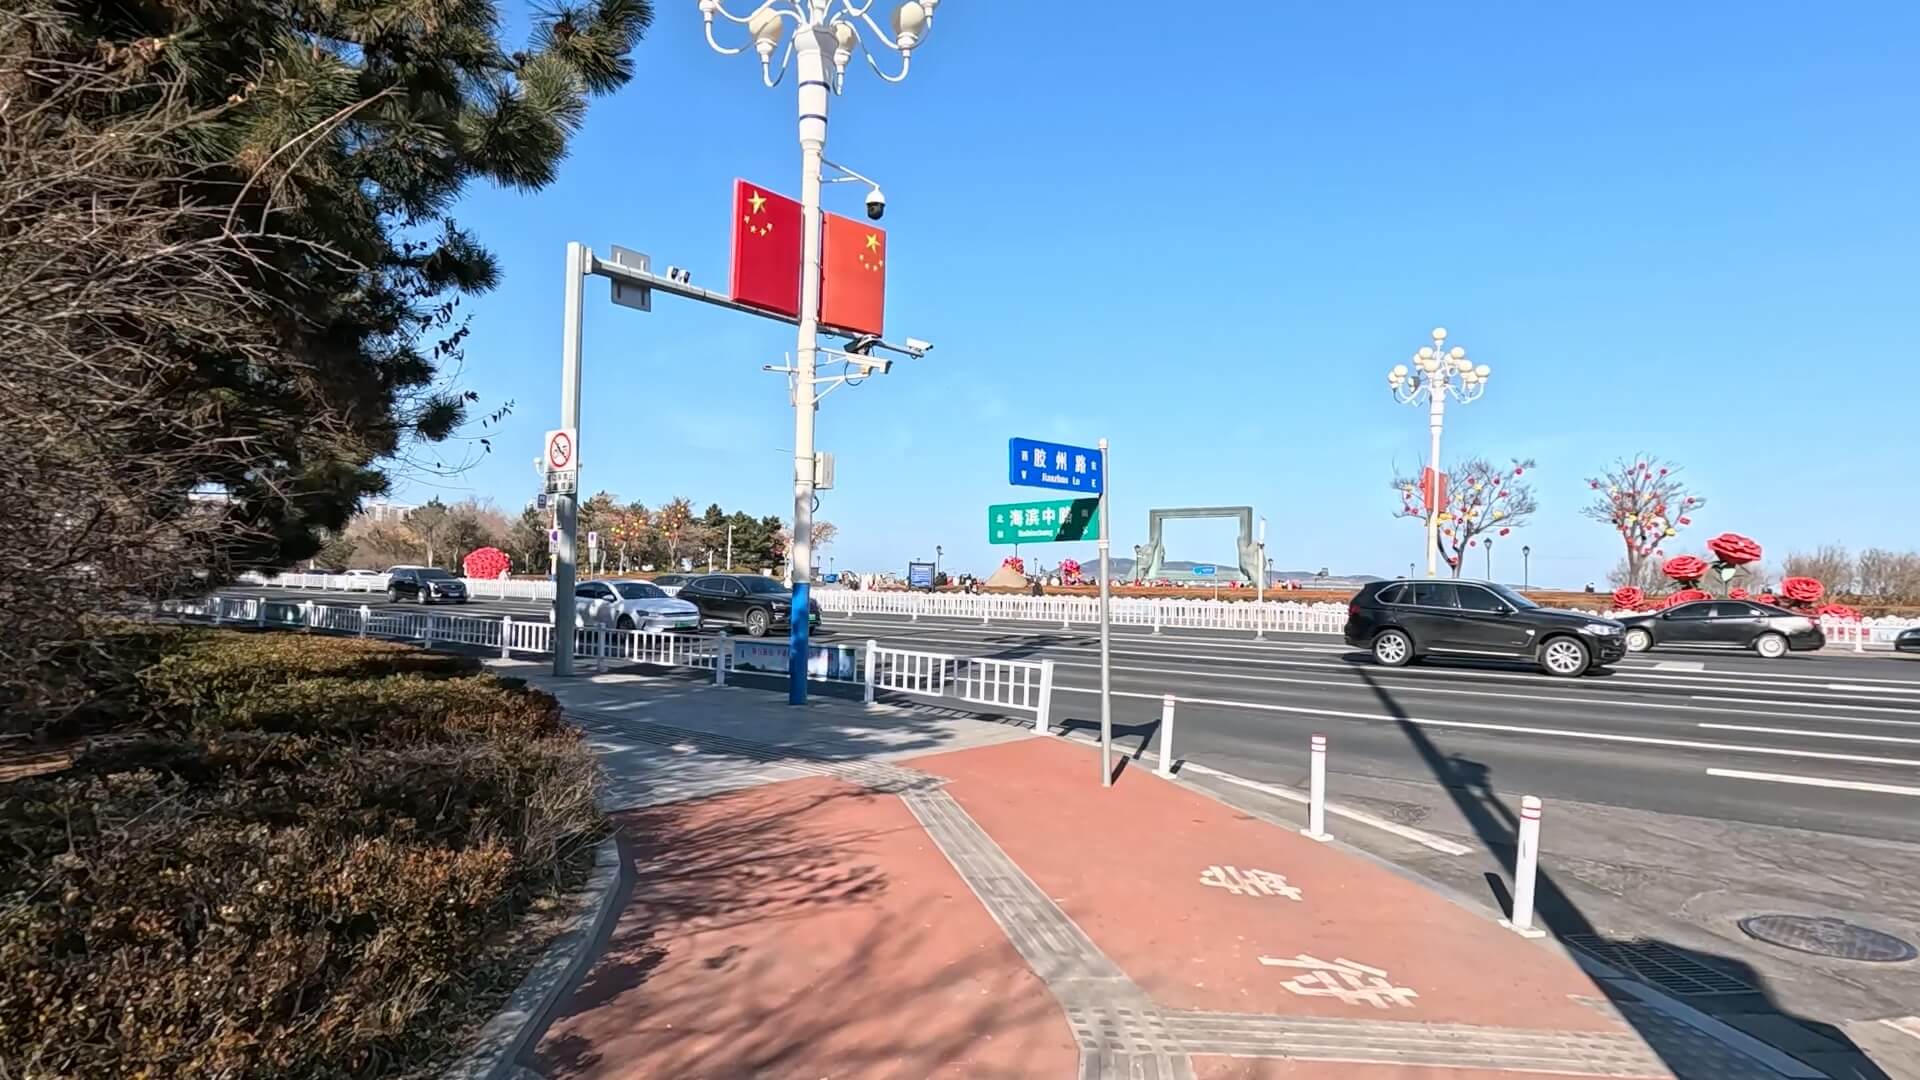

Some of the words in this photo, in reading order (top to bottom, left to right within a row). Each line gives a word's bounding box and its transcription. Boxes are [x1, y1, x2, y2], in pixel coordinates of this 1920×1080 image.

[1033, 448, 1086, 474] 胶州路
[1009, 506, 1072, 528] 海滨中路
